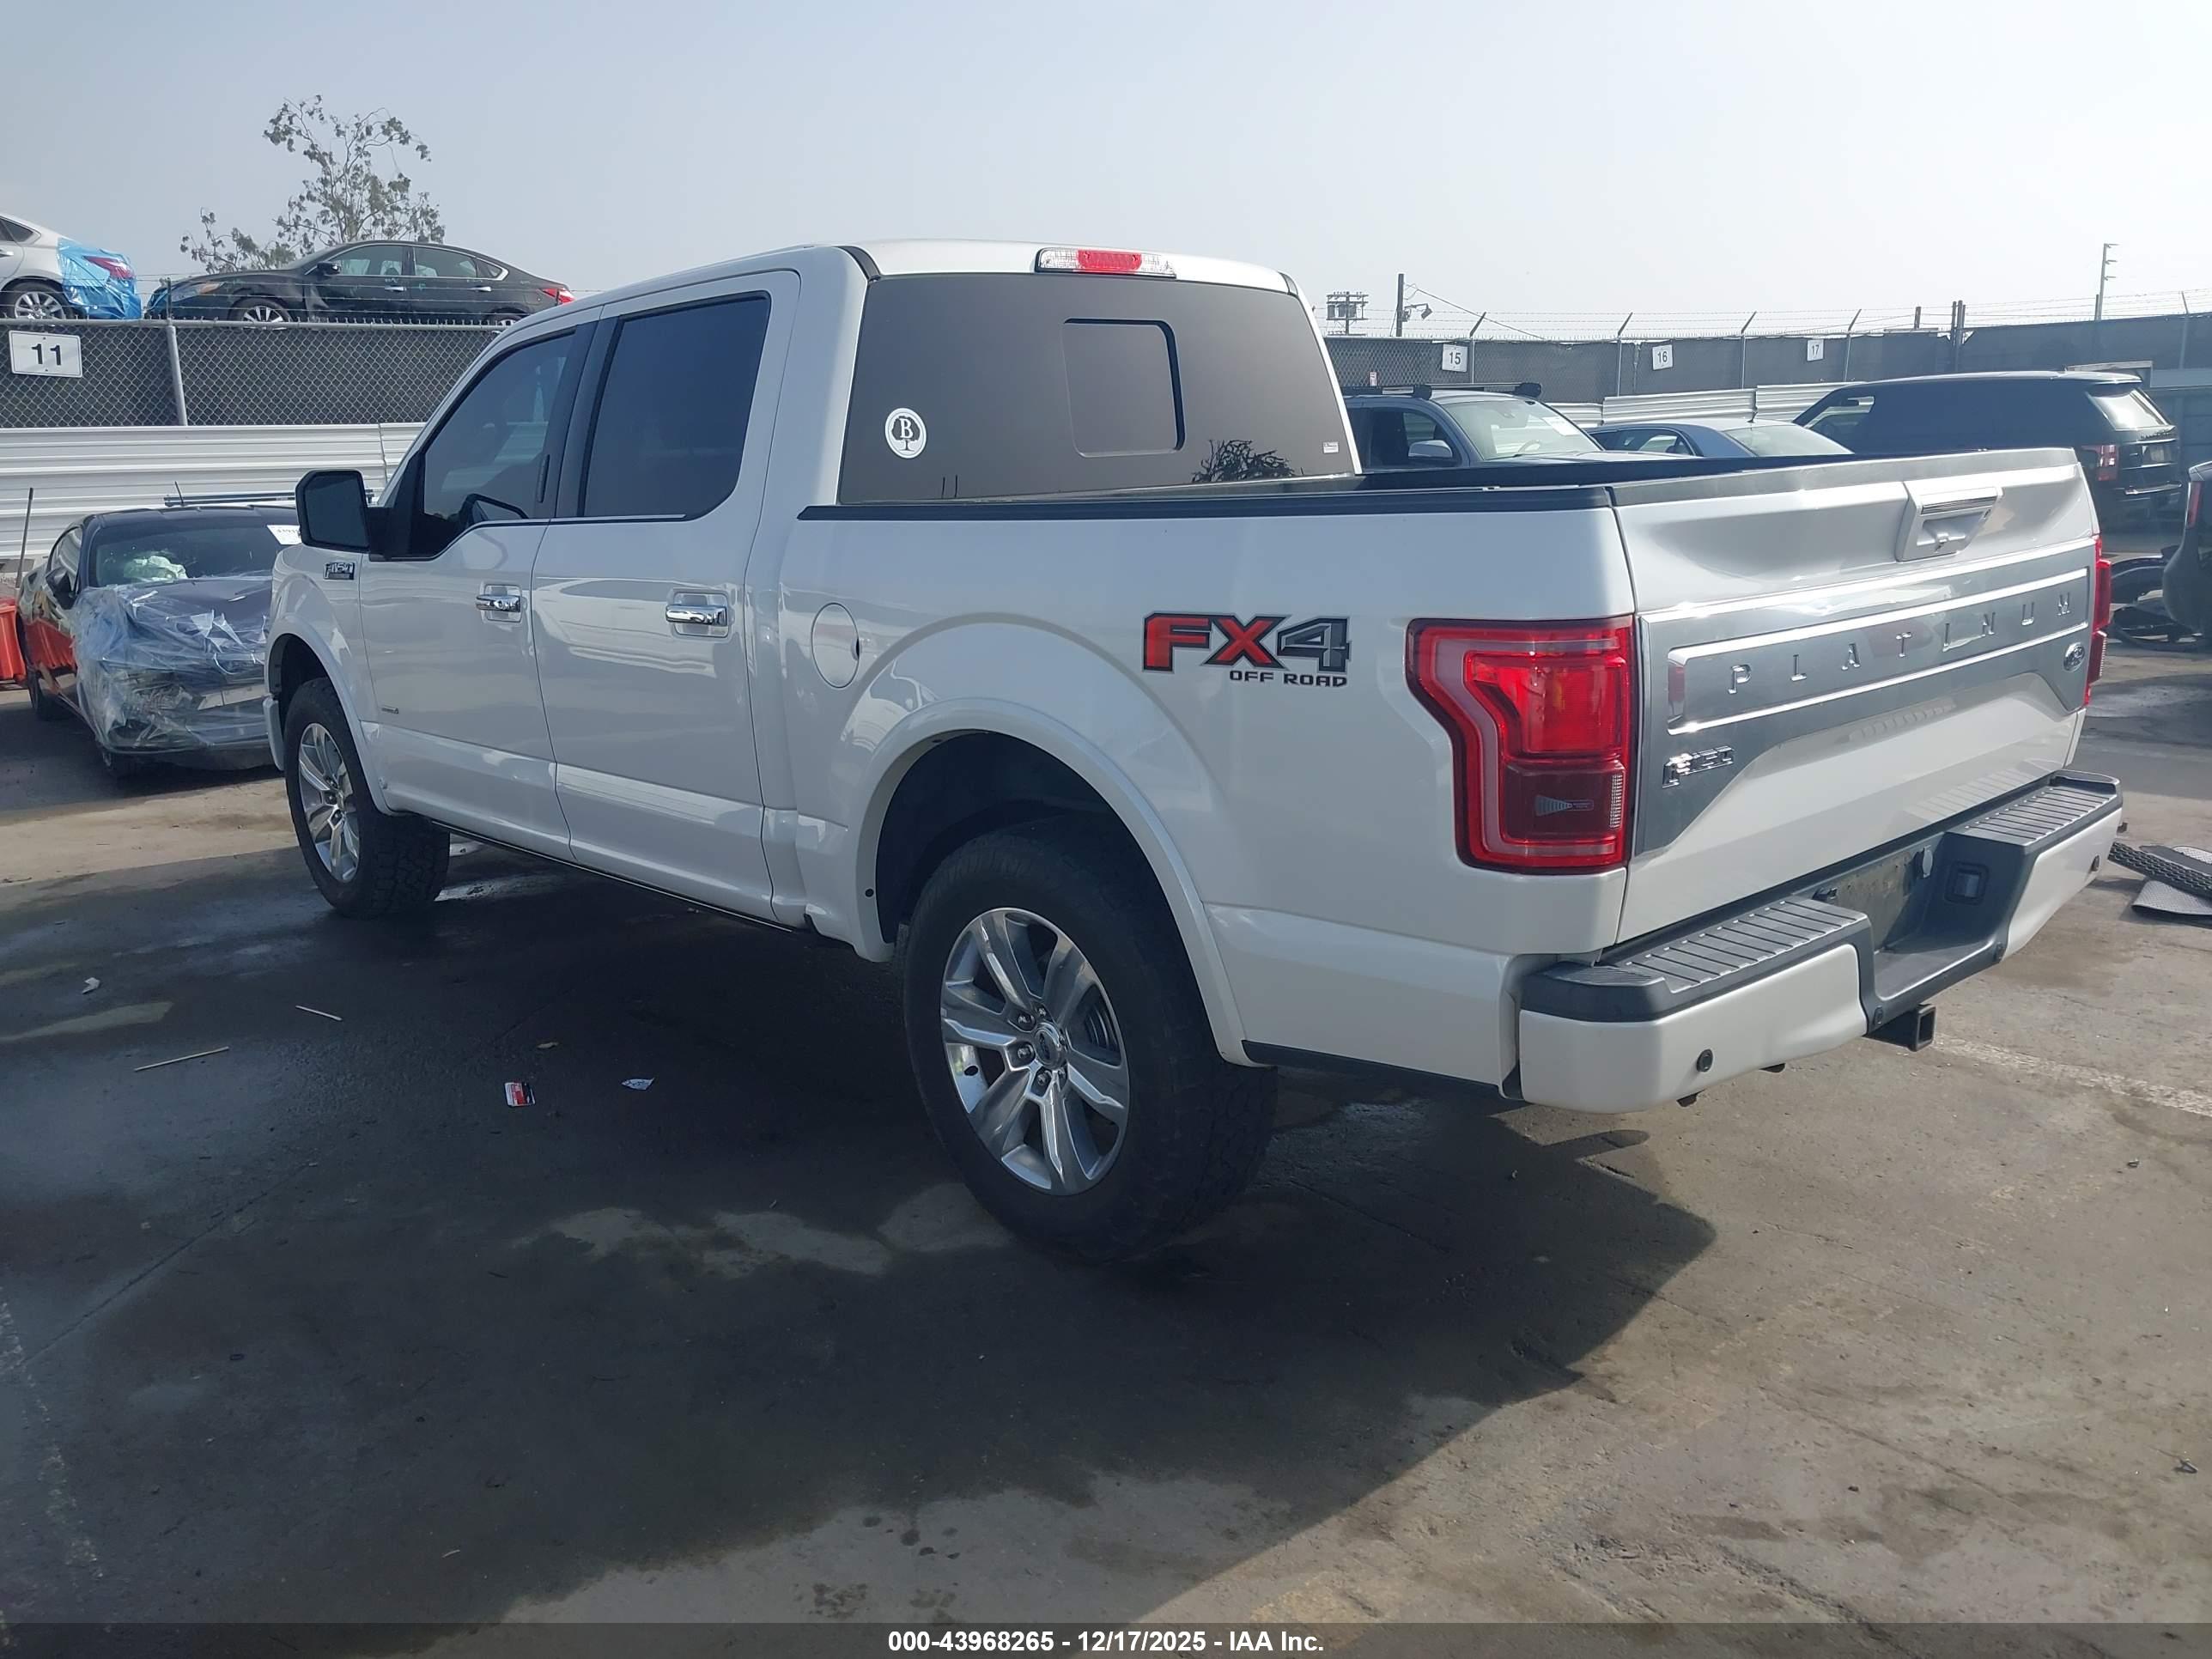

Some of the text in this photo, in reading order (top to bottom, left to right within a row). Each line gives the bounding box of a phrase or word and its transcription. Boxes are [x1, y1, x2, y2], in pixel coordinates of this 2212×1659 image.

[31, 343, 62, 366] 11
[1449, 351, 1462, 365] 15
[1657, 350, 1668, 363] 16
[1812, 344, 1820, 356] 17
[899, 417, 914, 439] B
[1143, 612, 1350, 672] FX4
[1229, 670, 1347, 687] OFF ROAD
